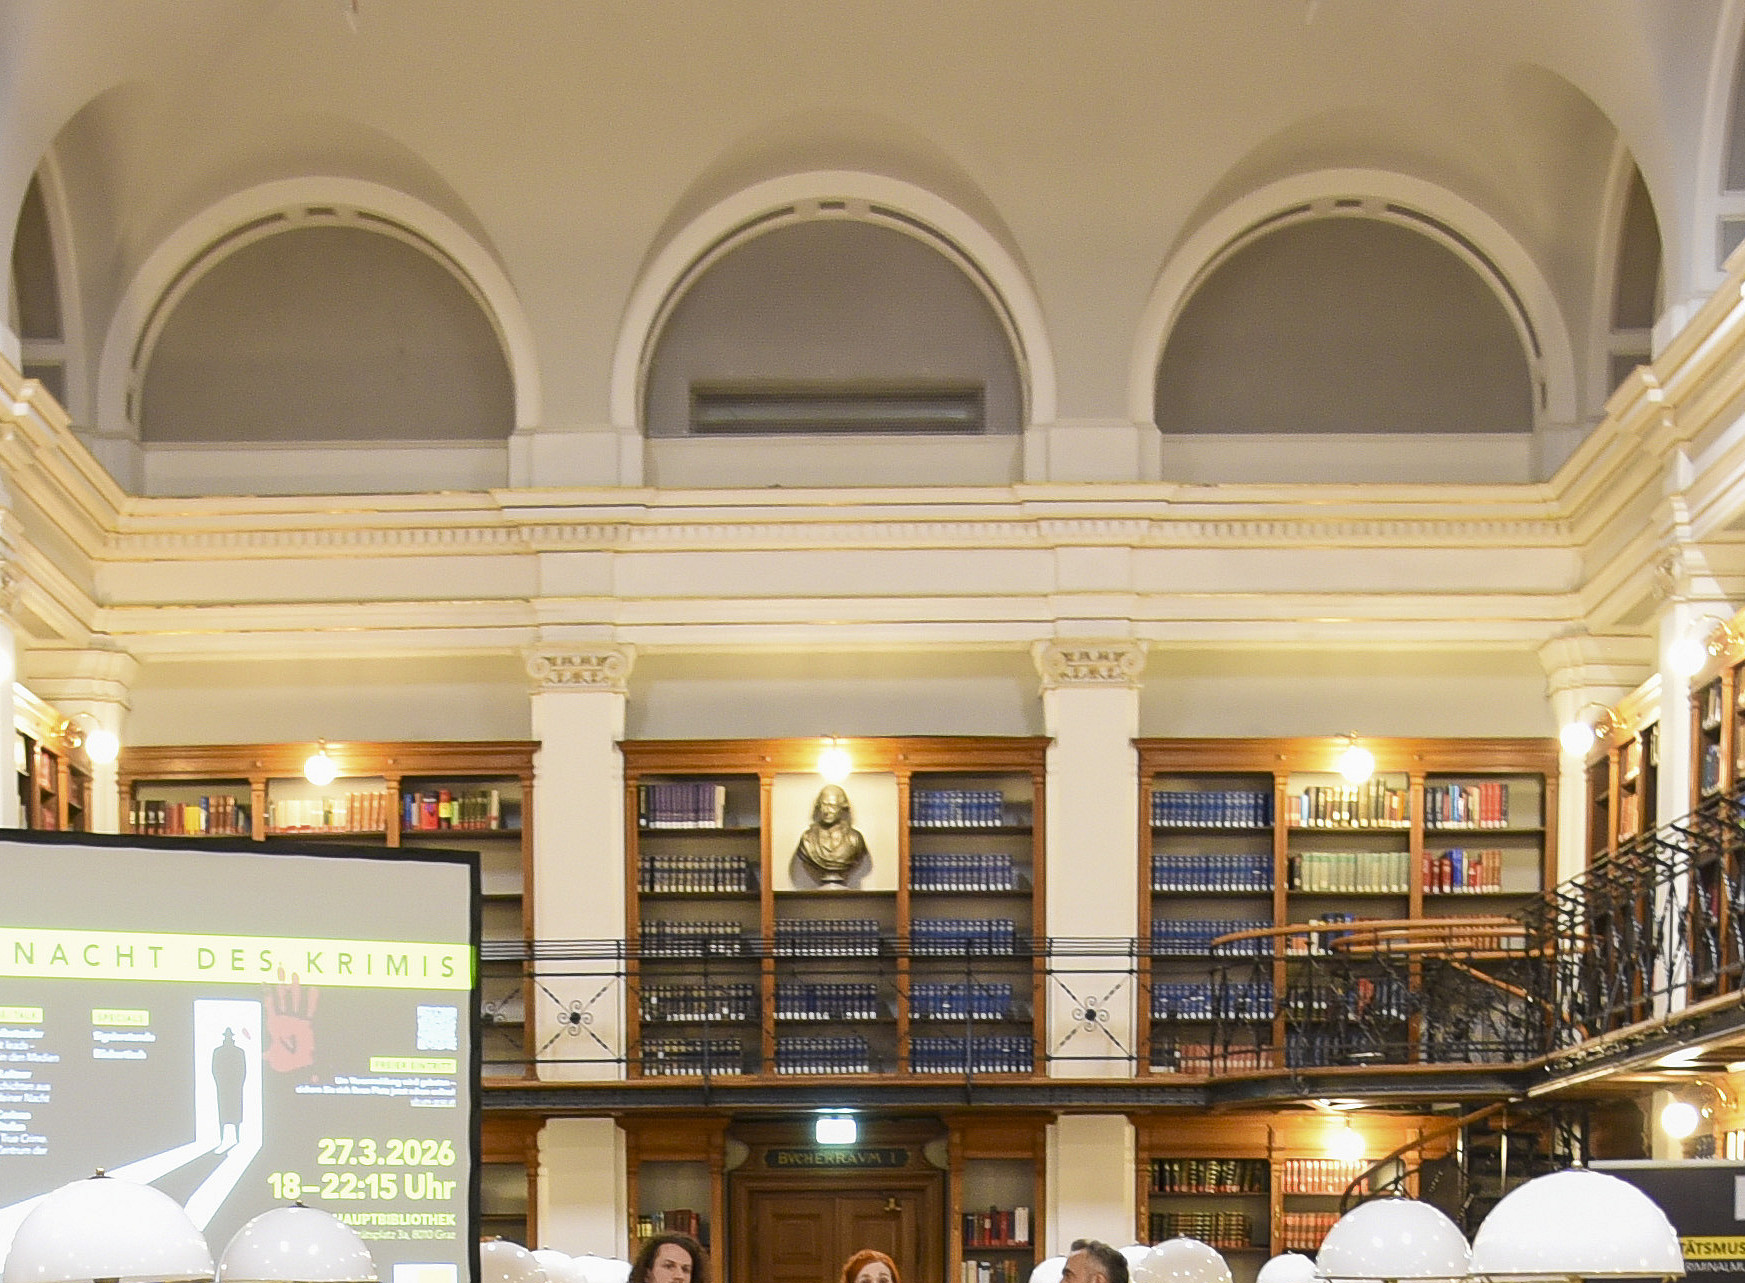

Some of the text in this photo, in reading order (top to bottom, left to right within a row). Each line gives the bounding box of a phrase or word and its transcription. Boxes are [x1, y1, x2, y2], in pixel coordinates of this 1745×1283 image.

[13, 941, 164, 970] NACHT
[197, 946, 274, 972] DES
[306, 951, 455, 978] KRIMIS
[316, 1138, 457, 1167] 27.3.2026
[403, 1172, 458, 1201] Uhr
